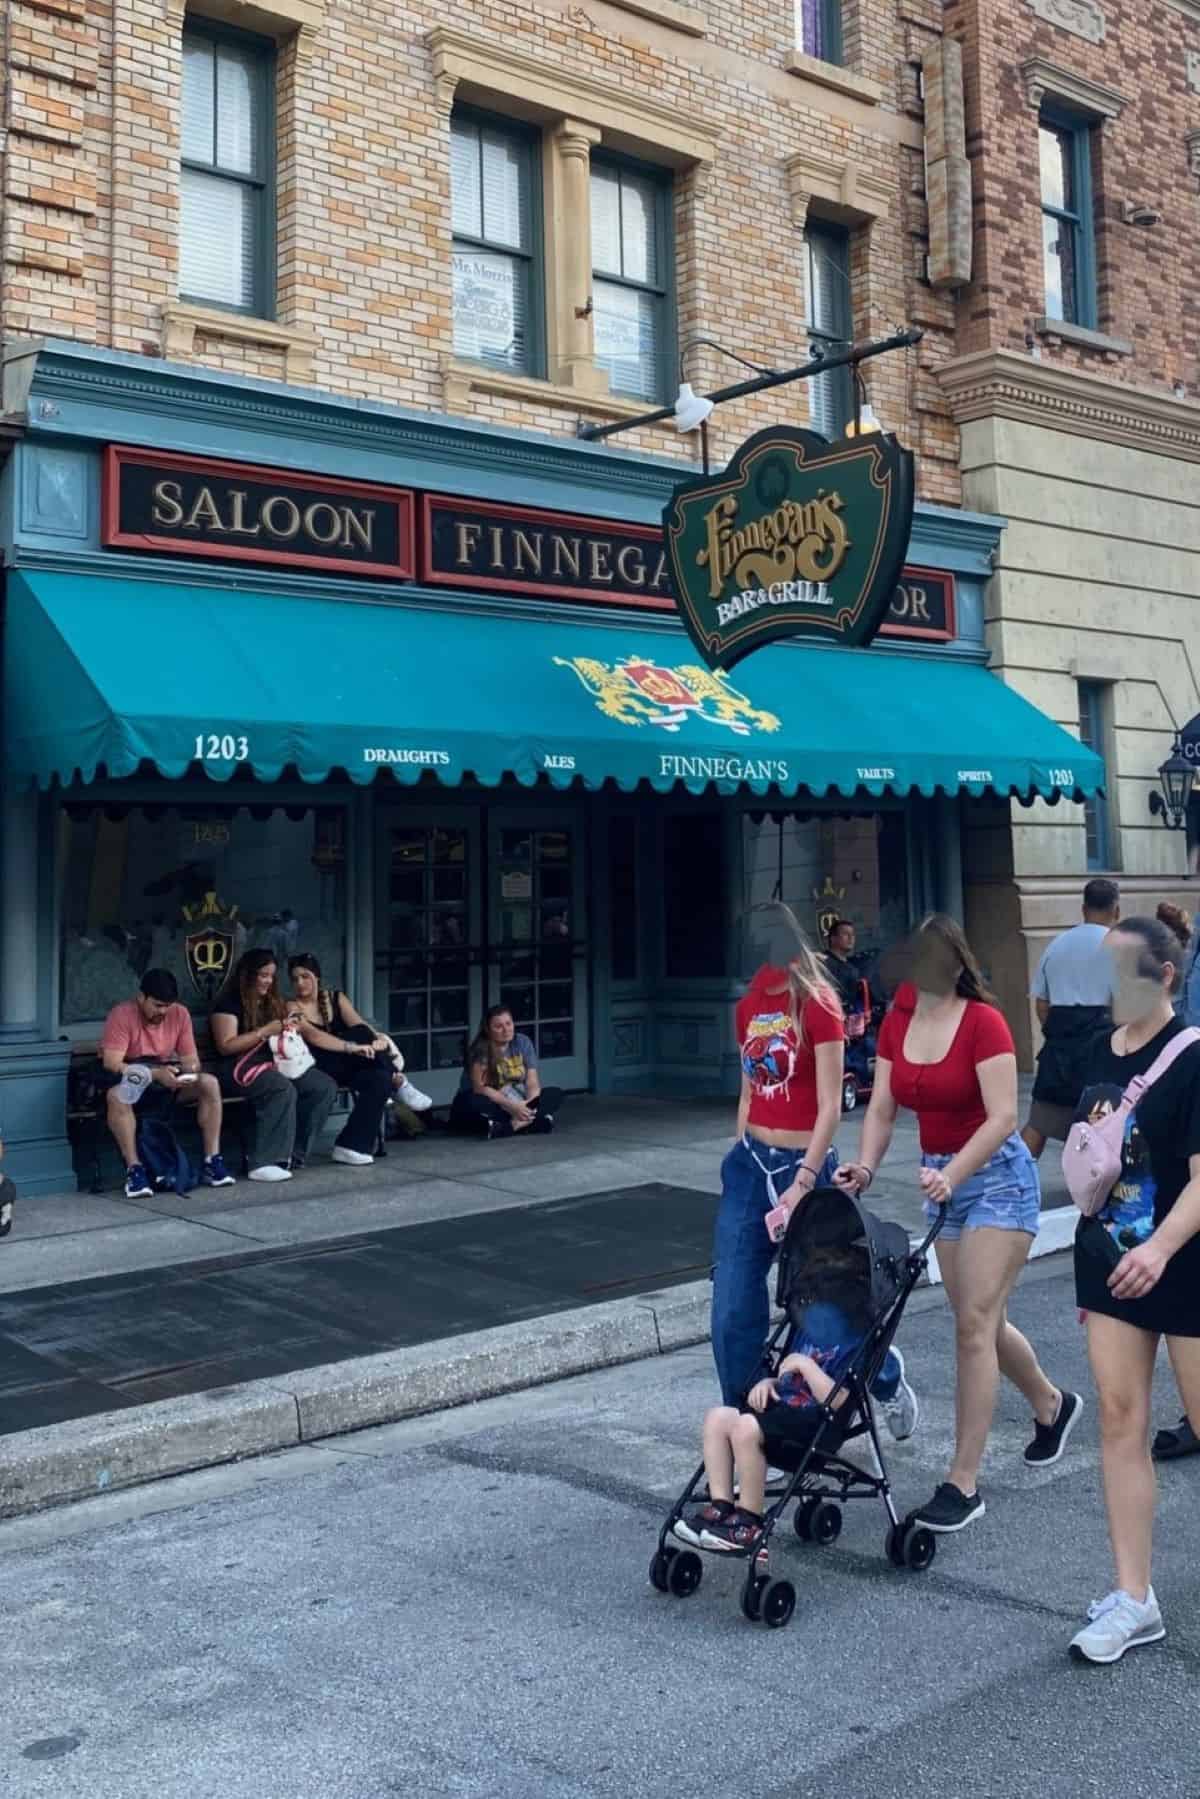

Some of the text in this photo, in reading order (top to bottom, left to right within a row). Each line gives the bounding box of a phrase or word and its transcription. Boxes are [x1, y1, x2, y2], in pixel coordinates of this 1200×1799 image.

[152, 480, 376, 551] SALOON
[194, 733, 249, 761] 1203
[363, 748, 450, 765] DRAUGHTS
[543, 754, 576, 769] ALES
[659, 755, 790, 781] FINNEGAN'S
[856, 767, 896, 780] VAULTS
[957, 770, 993, 783] SPIRITS
[1048, 768, 1074, 786] 1203
